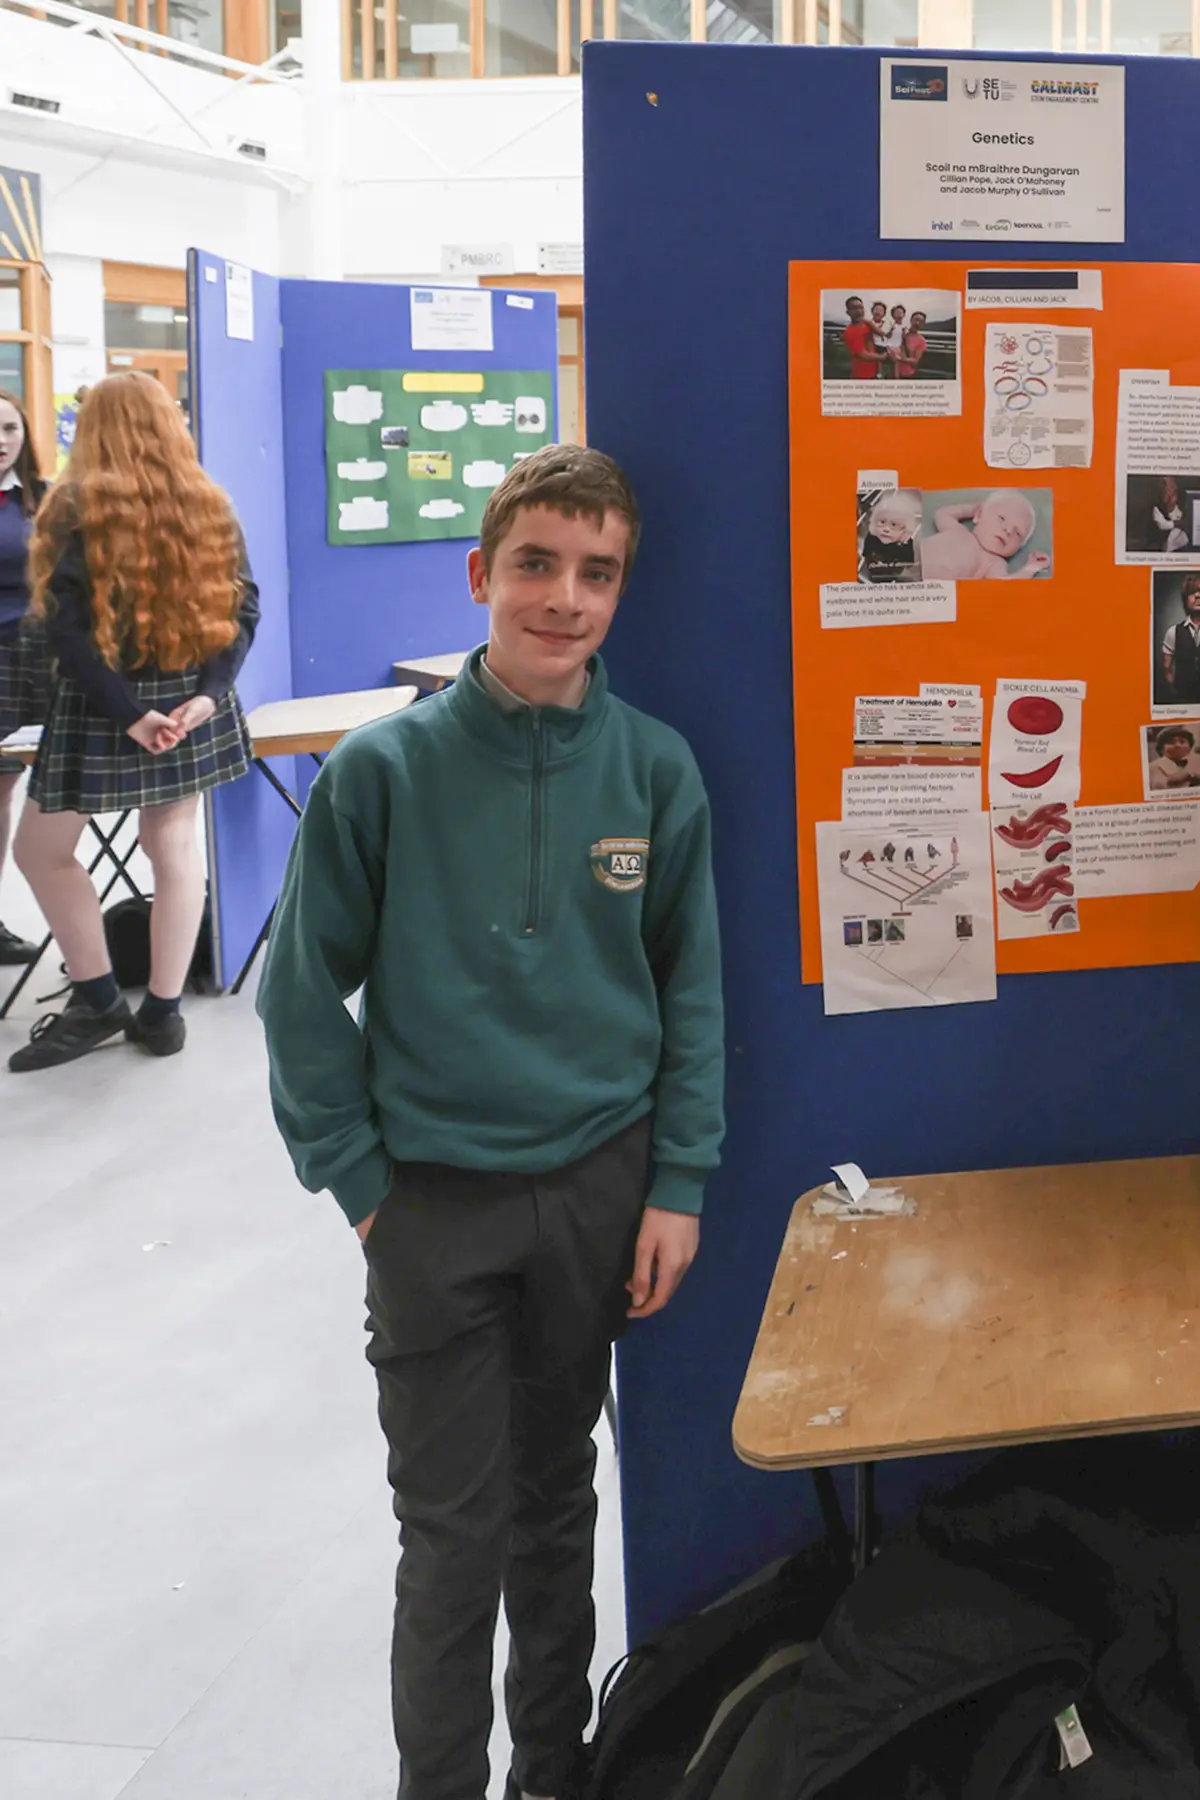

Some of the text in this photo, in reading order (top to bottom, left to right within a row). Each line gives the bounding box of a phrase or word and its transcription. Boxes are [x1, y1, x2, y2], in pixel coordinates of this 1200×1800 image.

[983, 78, 999, 89] SE
[1031, 80, 1099, 95] CALMAST
[983, 90, 999, 101] TU
[972, 132, 1035, 145] Genetics
[925, 163, 1080, 177] Scoil na mBraithre Dungarvan
[940, 175, 1066, 187] Cillian Pope, Jack O'Mahoney
[940, 185, 1066, 196] and Jacob Murphy O'Sullivan
[931, 221, 953, 231] intel
[840, 586, 867, 594] person
[884, 583, 898, 591] has
[858, 596, 873, 604] and
[874, 595, 894, 603] white
[910, 594, 925, 602] and
[931, 595, 947, 603] very
[844, 609, 860, 617] face
[875, 608, 895, 617] quite
[926, 687, 973, 696] HEMOPHILIA
[1030, 684, 1049, 692] CELL
[1050, 685, 1079, 693] ANEMIA
[906, 698, 943, 707] Hemophilia
[890, 785, 899, 793] by
